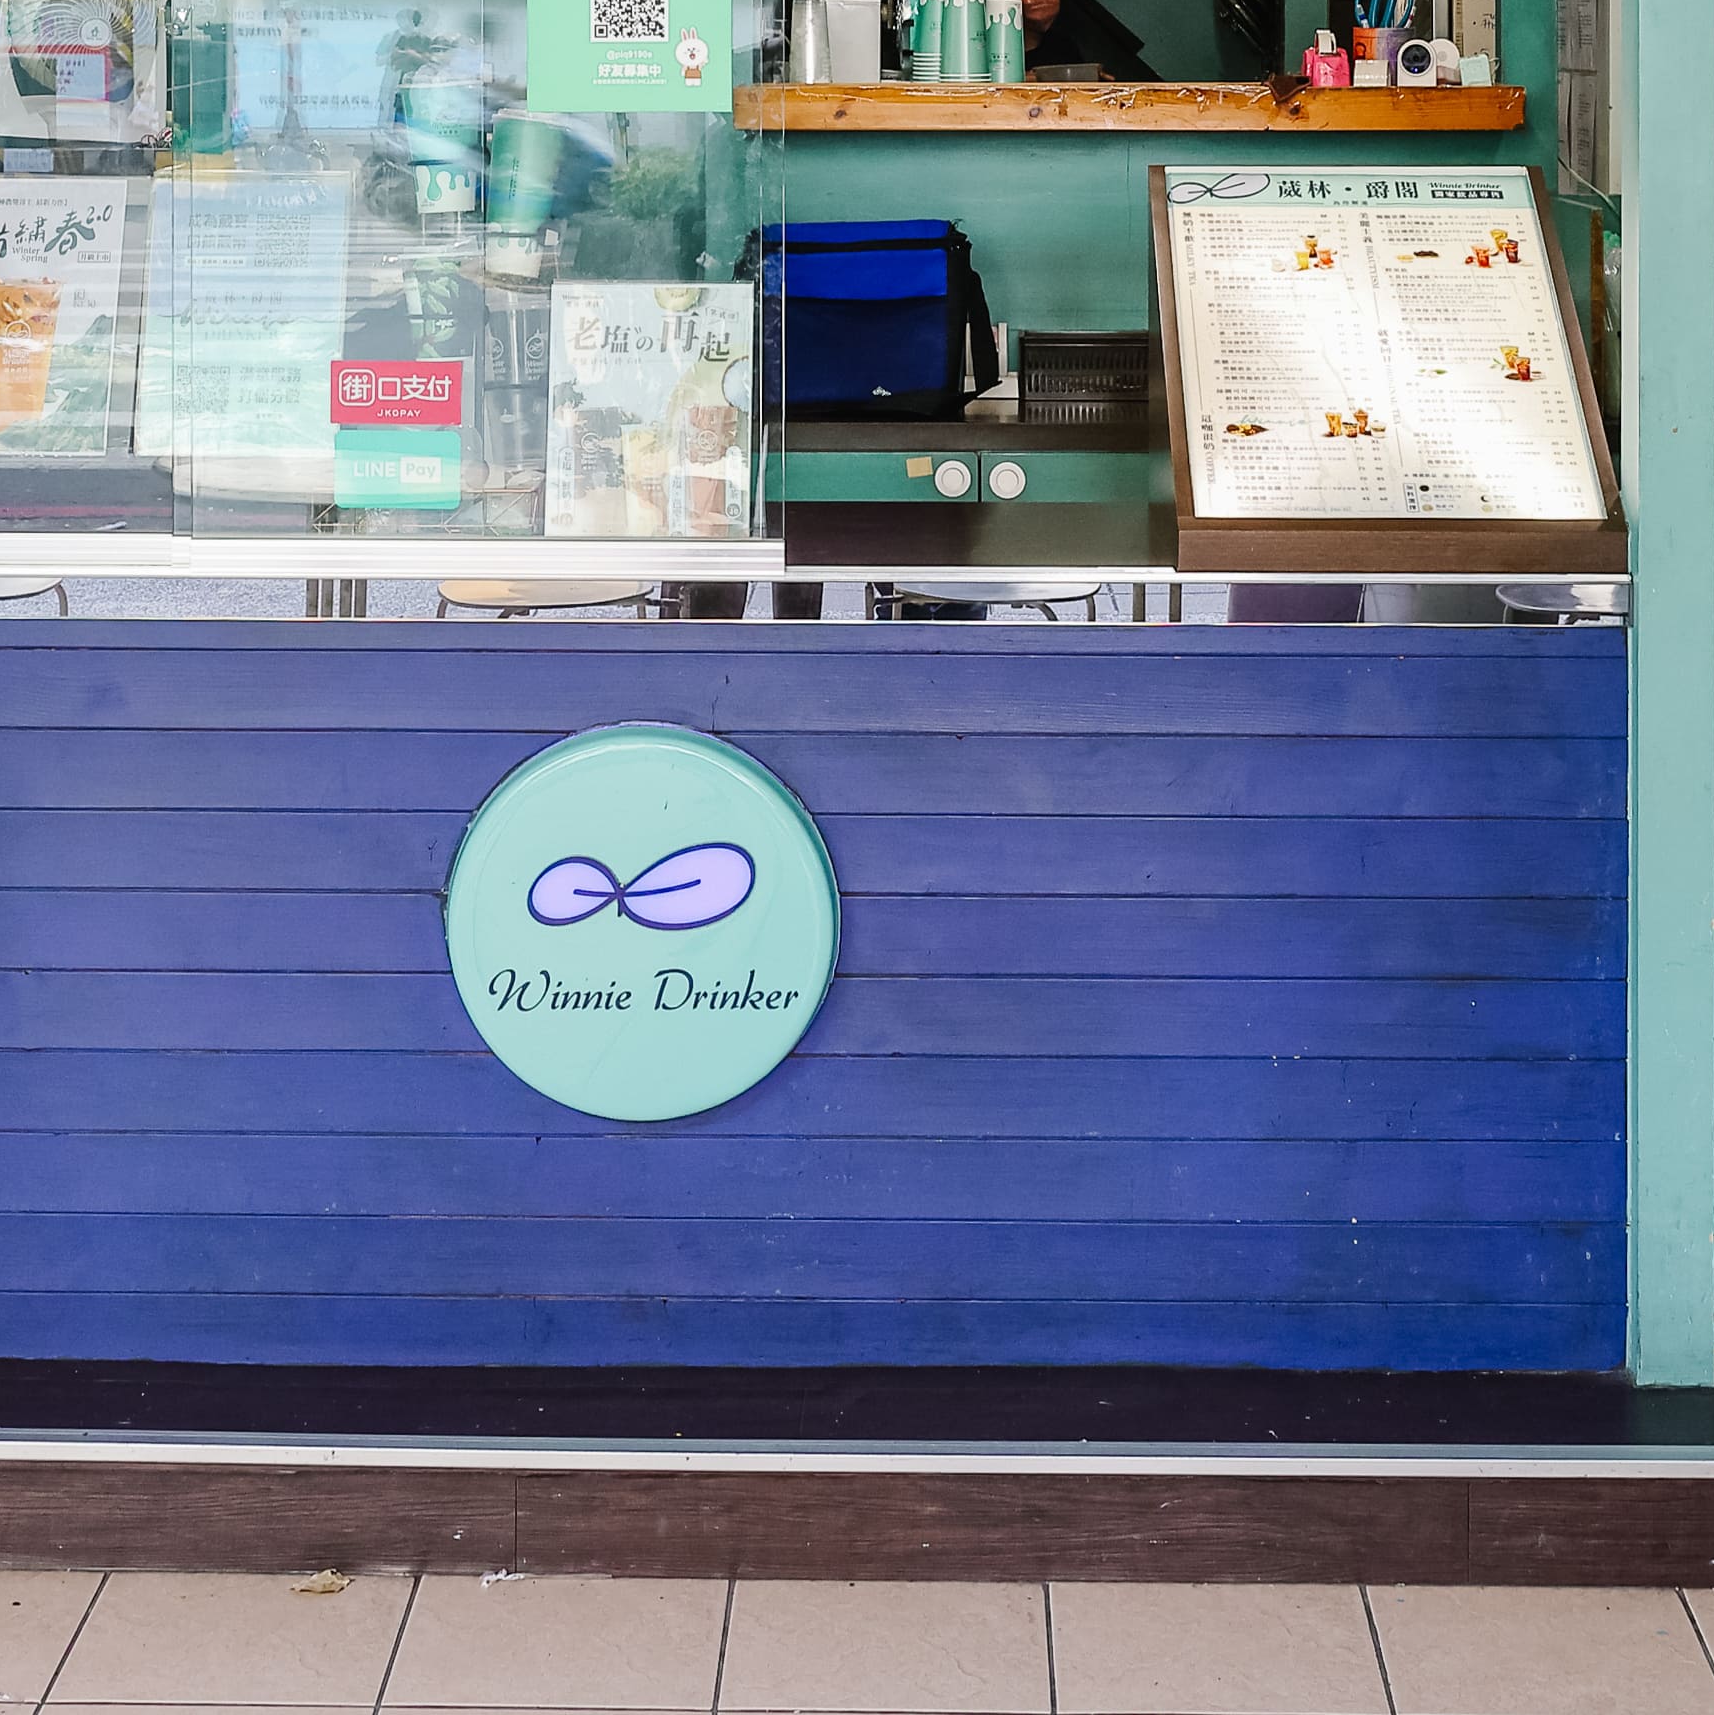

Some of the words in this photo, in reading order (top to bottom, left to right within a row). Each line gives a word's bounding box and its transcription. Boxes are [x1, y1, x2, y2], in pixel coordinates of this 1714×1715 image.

[86, 204, 114, 226] 2.0
[12, 246, 41, 255] Winter
[20, 253, 49, 264] Spring
[341, 373, 453, 402] 街口支付
[376, 409, 422, 417] JKOPAY
[353, 460, 397, 478] LINE
[405, 462, 436, 478] Pay
[488, 969, 633, 1012] Winnie
[653, 969, 800, 1012] Drinker
